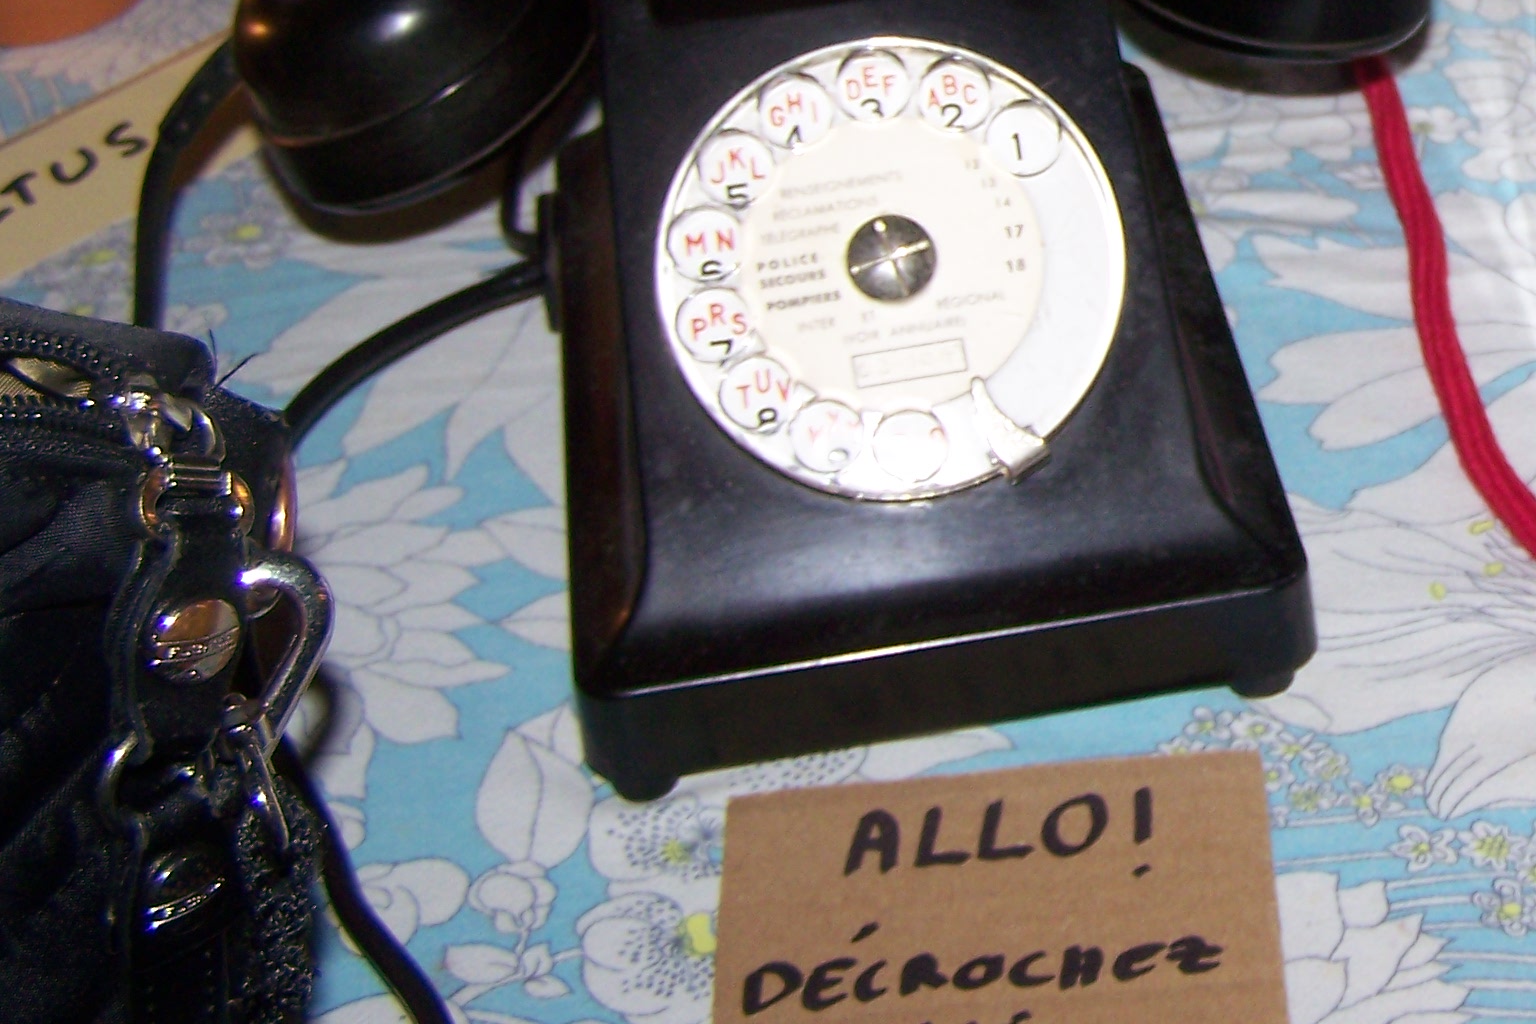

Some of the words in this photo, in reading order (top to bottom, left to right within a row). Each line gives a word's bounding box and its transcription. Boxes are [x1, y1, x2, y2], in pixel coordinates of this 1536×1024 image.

[846, 65, 895, 100] DEF
[928, 74, 978, 108] ABC
[770, 91, 819, 127] GHI
[941, 103, 966, 129] 2
[1012, 132, 1023, 161] 1
[0, 120, 149, 224] TUS
[710, 147, 766, 184] JKL
[725, 183, 749, 210] 5
[684, 227, 735, 257] MN
[759, 268, 827, 289] SECOURS
[1004, 223, 1024, 239] 17
[756, 251, 819, 272] POLICE
[766, 289, 842, 311] POMPIERS
[1005, 257, 1026, 273] 18
[690, 302, 748, 342] PRS
[736, 368, 792, 410] TUV
[844, 786, 1153, 877] ALLO!
